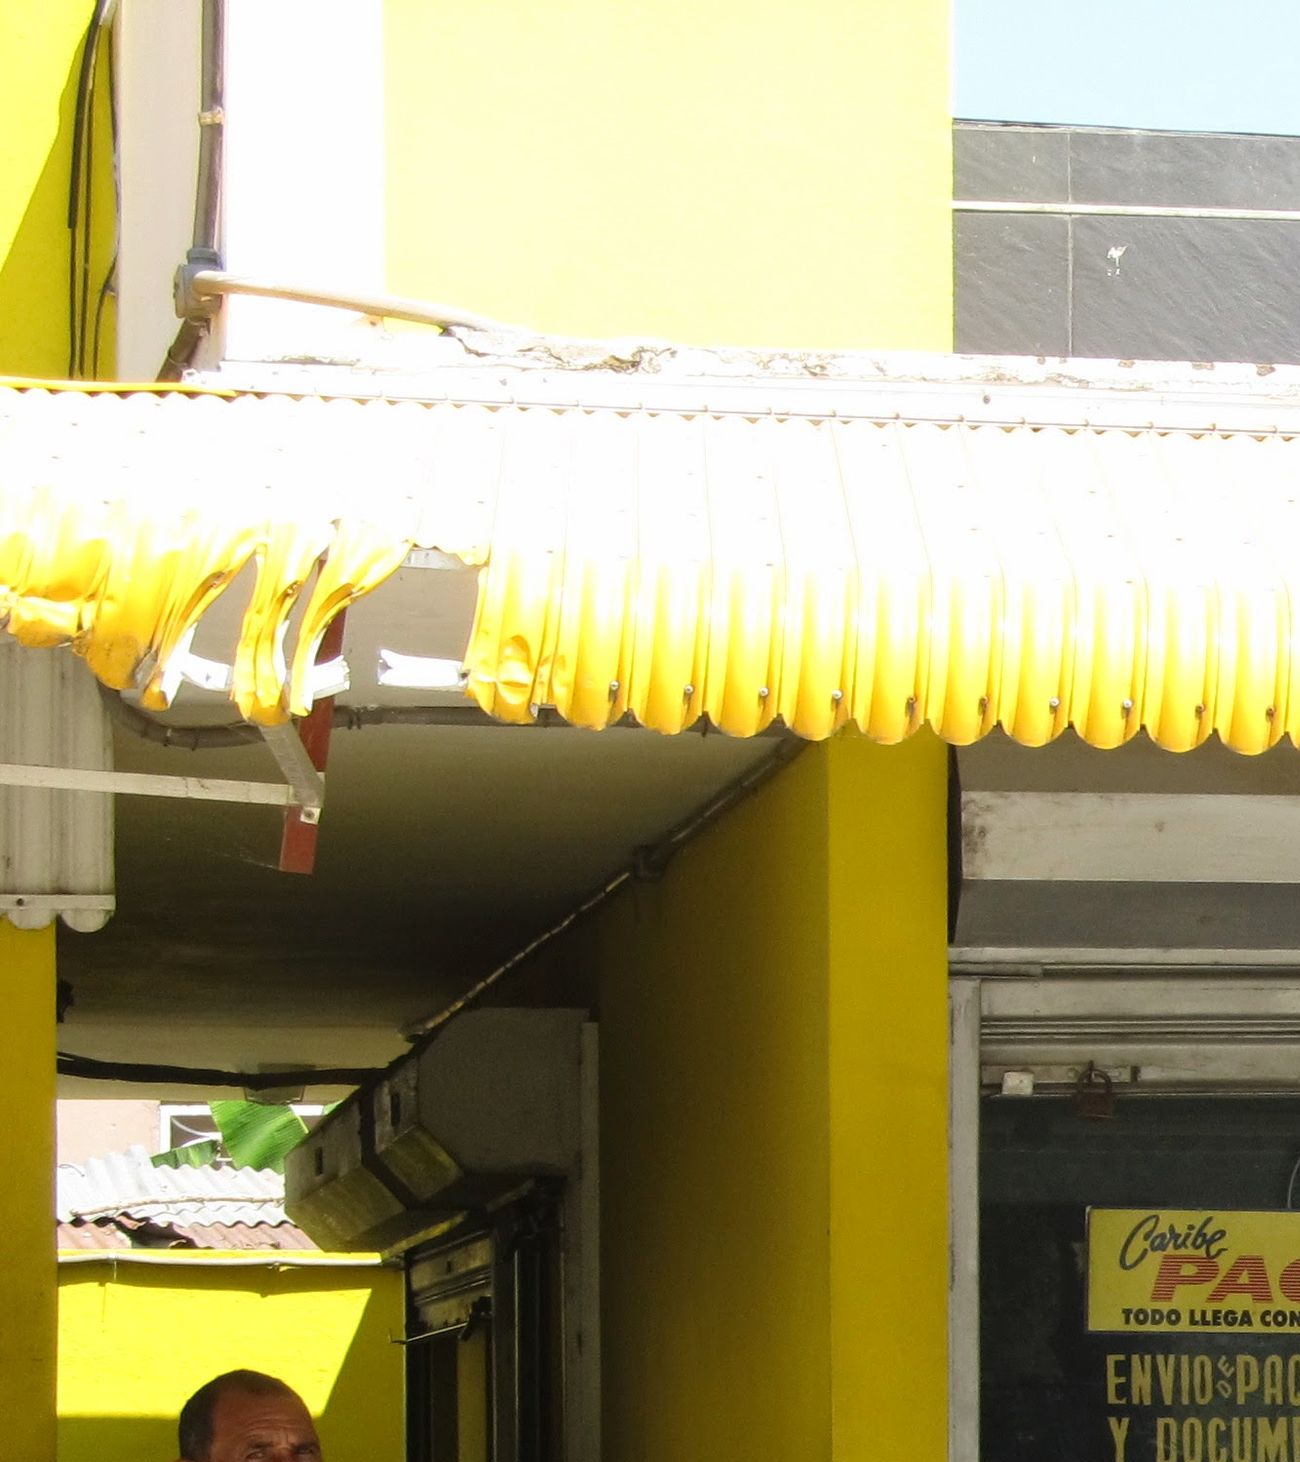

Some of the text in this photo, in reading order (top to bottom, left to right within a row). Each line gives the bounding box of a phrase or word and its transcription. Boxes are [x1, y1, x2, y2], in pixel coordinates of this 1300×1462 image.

[1118, 1215, 1229, 1271] Caribe
[1121, 1308, 1182, 1327] TODO
[1187, 1308, 1253, 1328] LLEGA
[1105, 1353, 1210, 1406] ENVIO
[1216, 1357, 1235, 1400] DE
